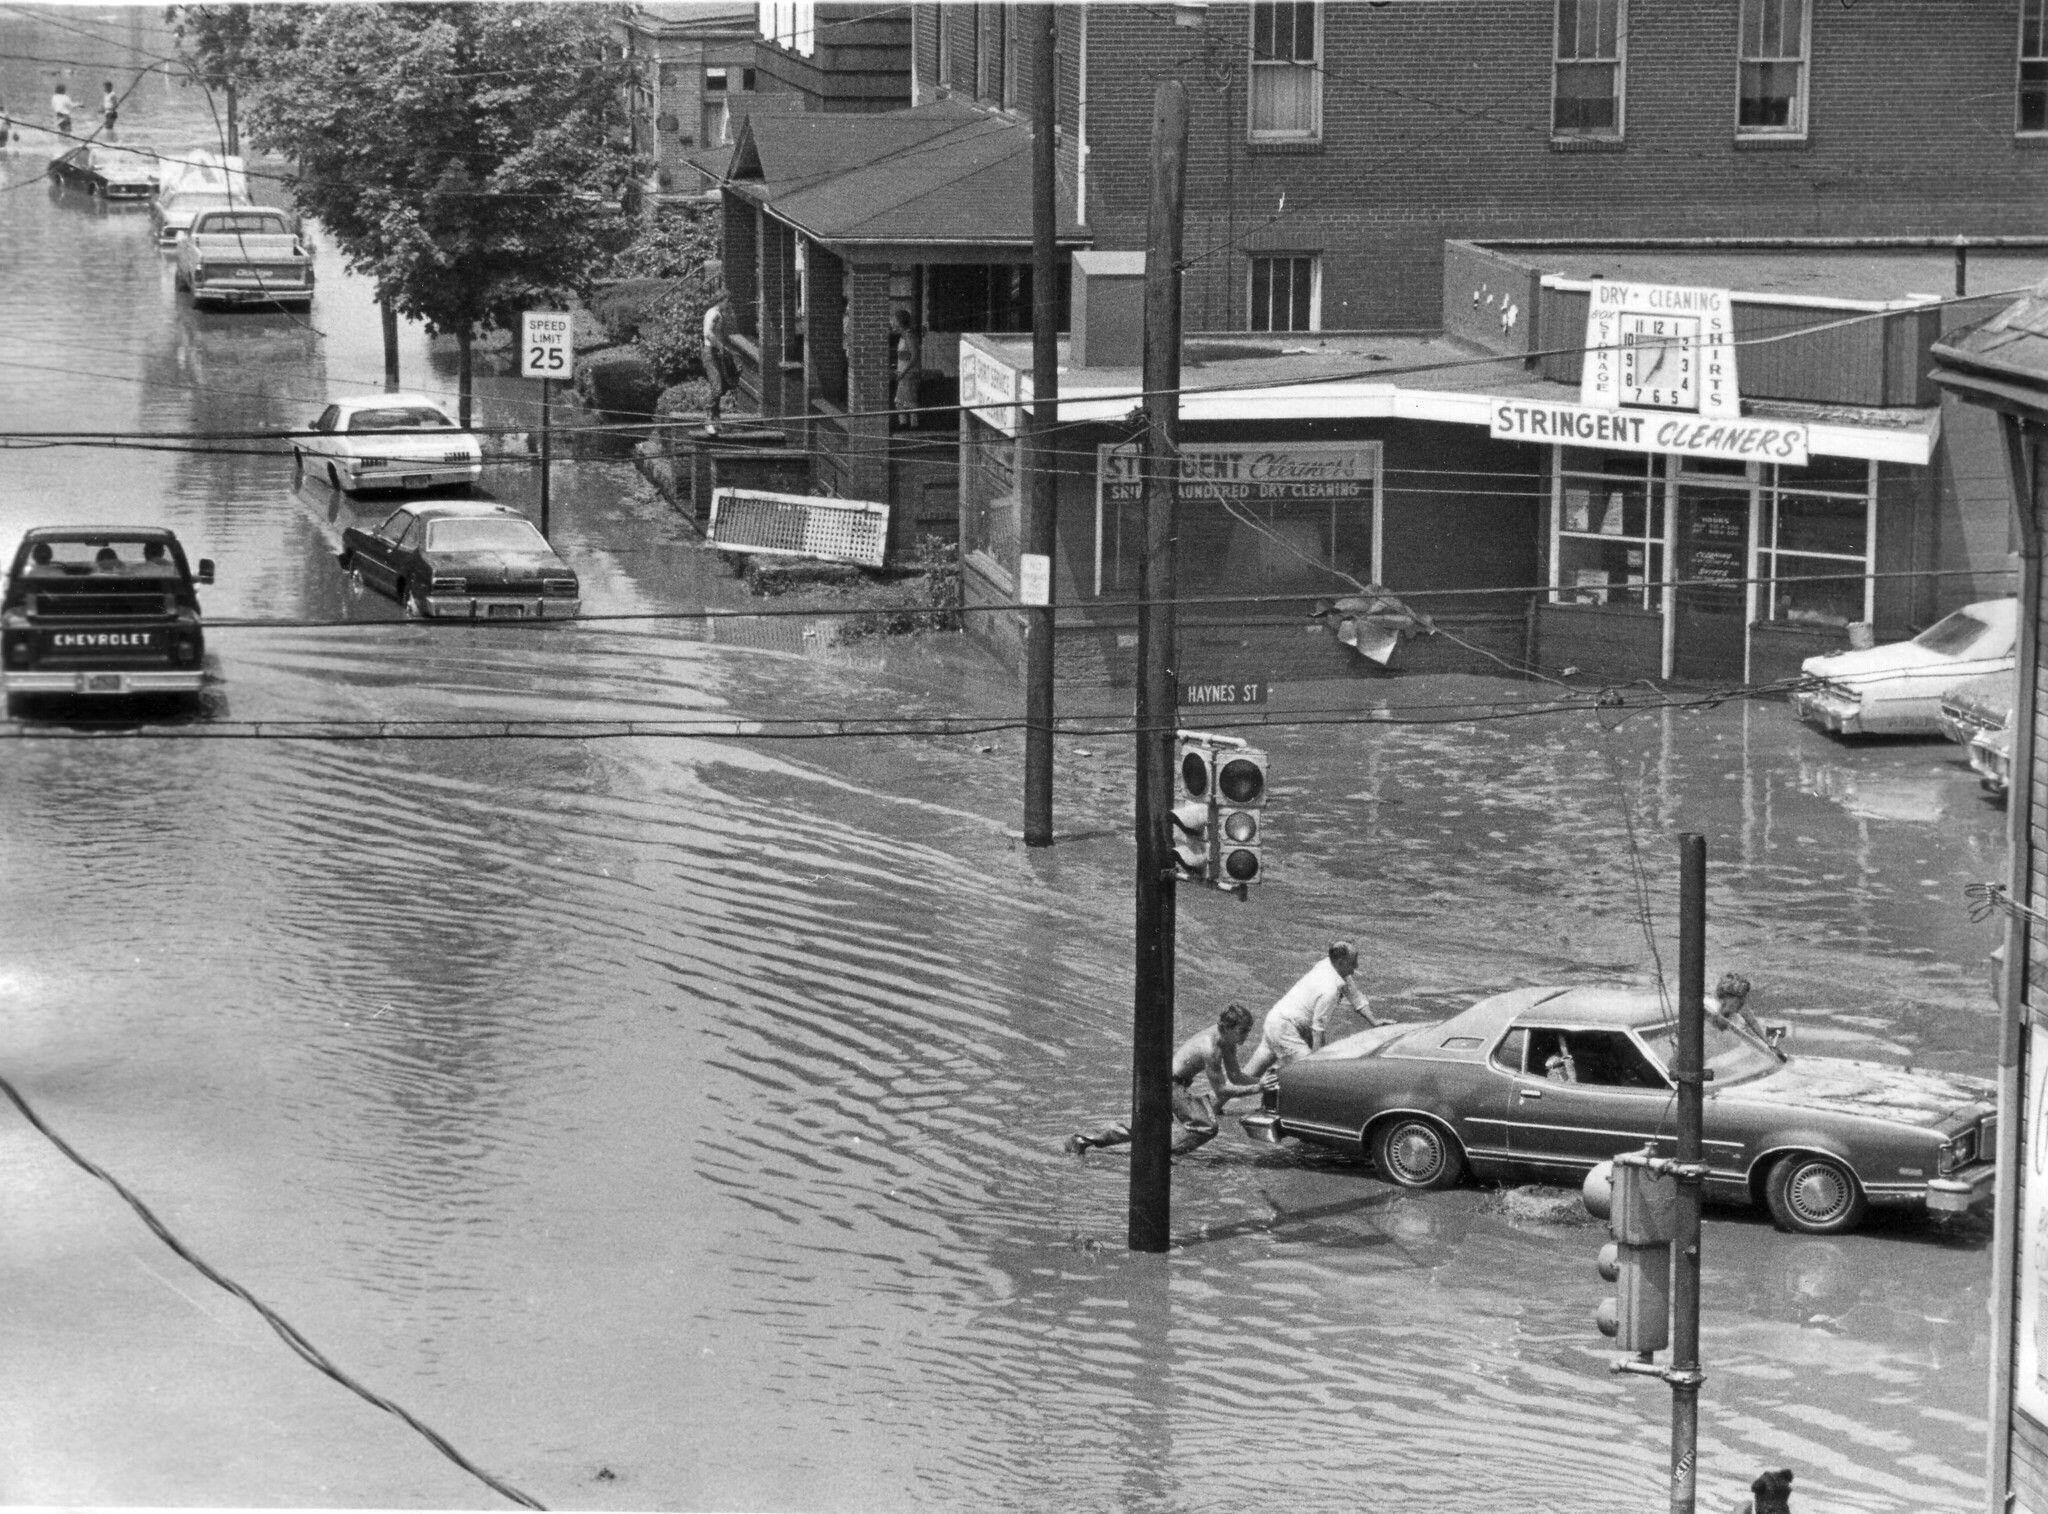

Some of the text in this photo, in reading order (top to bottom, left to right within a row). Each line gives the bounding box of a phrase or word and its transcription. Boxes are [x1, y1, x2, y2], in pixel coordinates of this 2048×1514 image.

[1600, 286, 1721, 311] DRY CLEANING
[1590, 310, 1615, 320] BOX
[529, 320, 566, 331] SPEED
[1635, 319, 1644, 333] 11
[1653, 321, 1664, 335] 12
[1674, 322, 1679, 336] 1
[532, 333, 563, 344] LIMIT
[1624, 333, 1634, 347] 10
[1682, 337, 1690, 352] 2
[530, 346, 564, 370] 25
[1626, 353, 1633, 367] 9
[1709, 317, 1723, 407] SHIRTS
[1681, 359, 1689, 373] 3
[1626, 373, 1633, 387] 8
[1681, 377, 1689, 391] 4
[1635, 388, 1643, 401] 7
[1653, 389, 1660, 404] 6
[1671, 391, 1679, 405] 5
[1498, 406, 1800, 457] STRINGENT CLEANERS
[1106, 453, 1243, 479] STGENT
[1259, 483, 1286, 498] DRY
[1291, 482, 1359, 497] CLEANING
[54, 633, 151, 646] CHEVROLET
[1187, 683, 1259, 703] HAYNES ST
